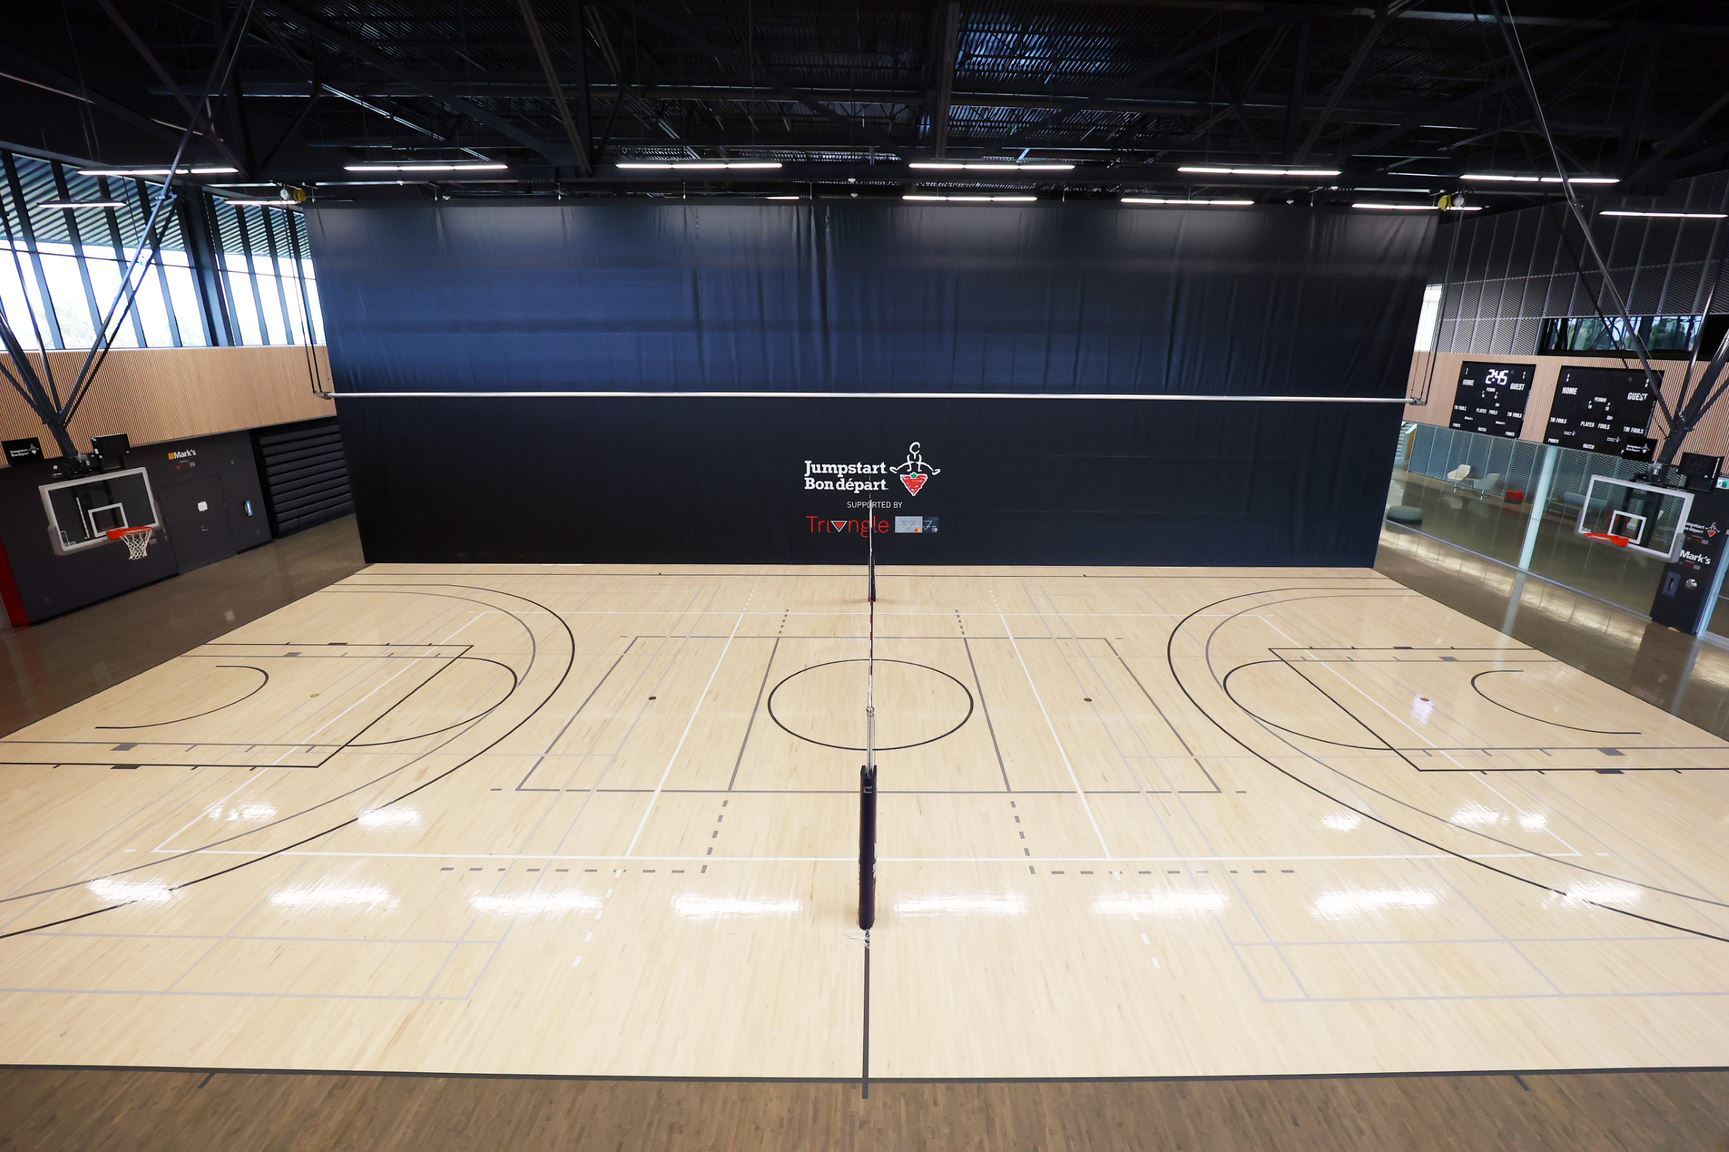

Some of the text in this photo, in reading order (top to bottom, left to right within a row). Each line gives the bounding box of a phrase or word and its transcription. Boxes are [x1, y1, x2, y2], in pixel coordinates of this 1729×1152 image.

[1562, 387, 1578, 395] HOME
[1627, 392, 1648, 401] GUEST
[173, 449, 196, 459] Mark's
[804, 460, 886, 478] Jumpstart
[804, 478, 887, 493] Bon départ
[1680, 549, 1711, 565] Mark's
